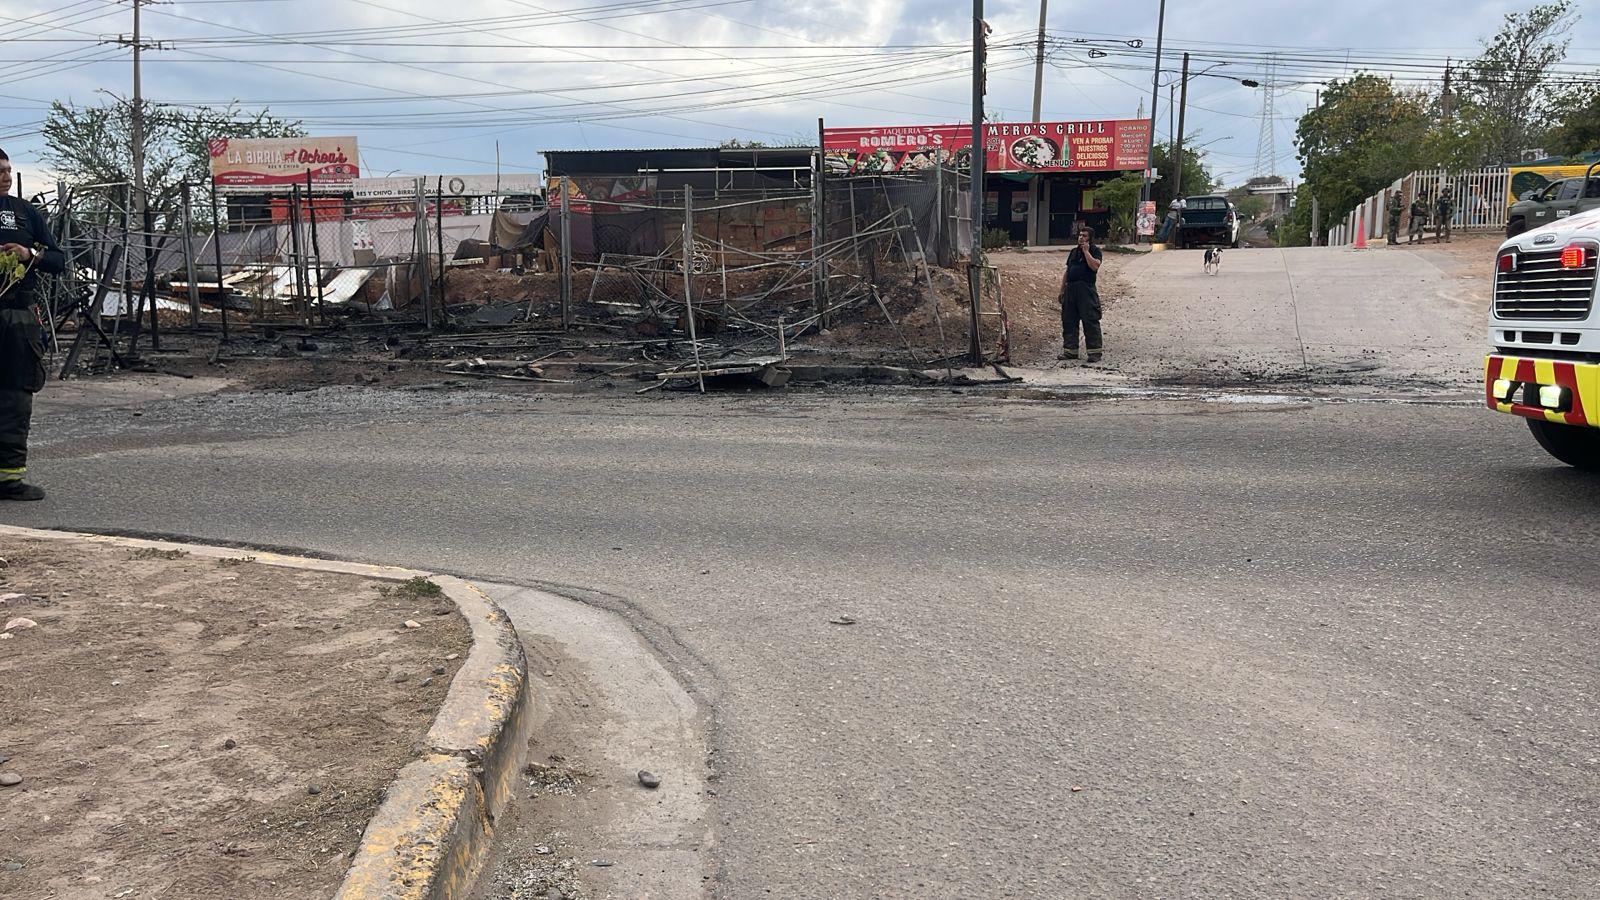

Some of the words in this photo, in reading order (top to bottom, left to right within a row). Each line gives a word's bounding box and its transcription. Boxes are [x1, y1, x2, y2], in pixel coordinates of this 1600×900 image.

[883, 127, 921, 135] TAQUERIA
[987, 125, 1047, 136] MERO'S
[1056, 122, 1105, 134] GRILL
[860, 133, 943, 147] ROMERO'S
[1091, 136, 1114, 144] PROBAR
[227, 151, 242, 164] LA
[246, 150, 282, 164] BIRRIA
[298, 147, 348, 164] Ochoa's
[1044, 159, 1075, 167] MENUDO
